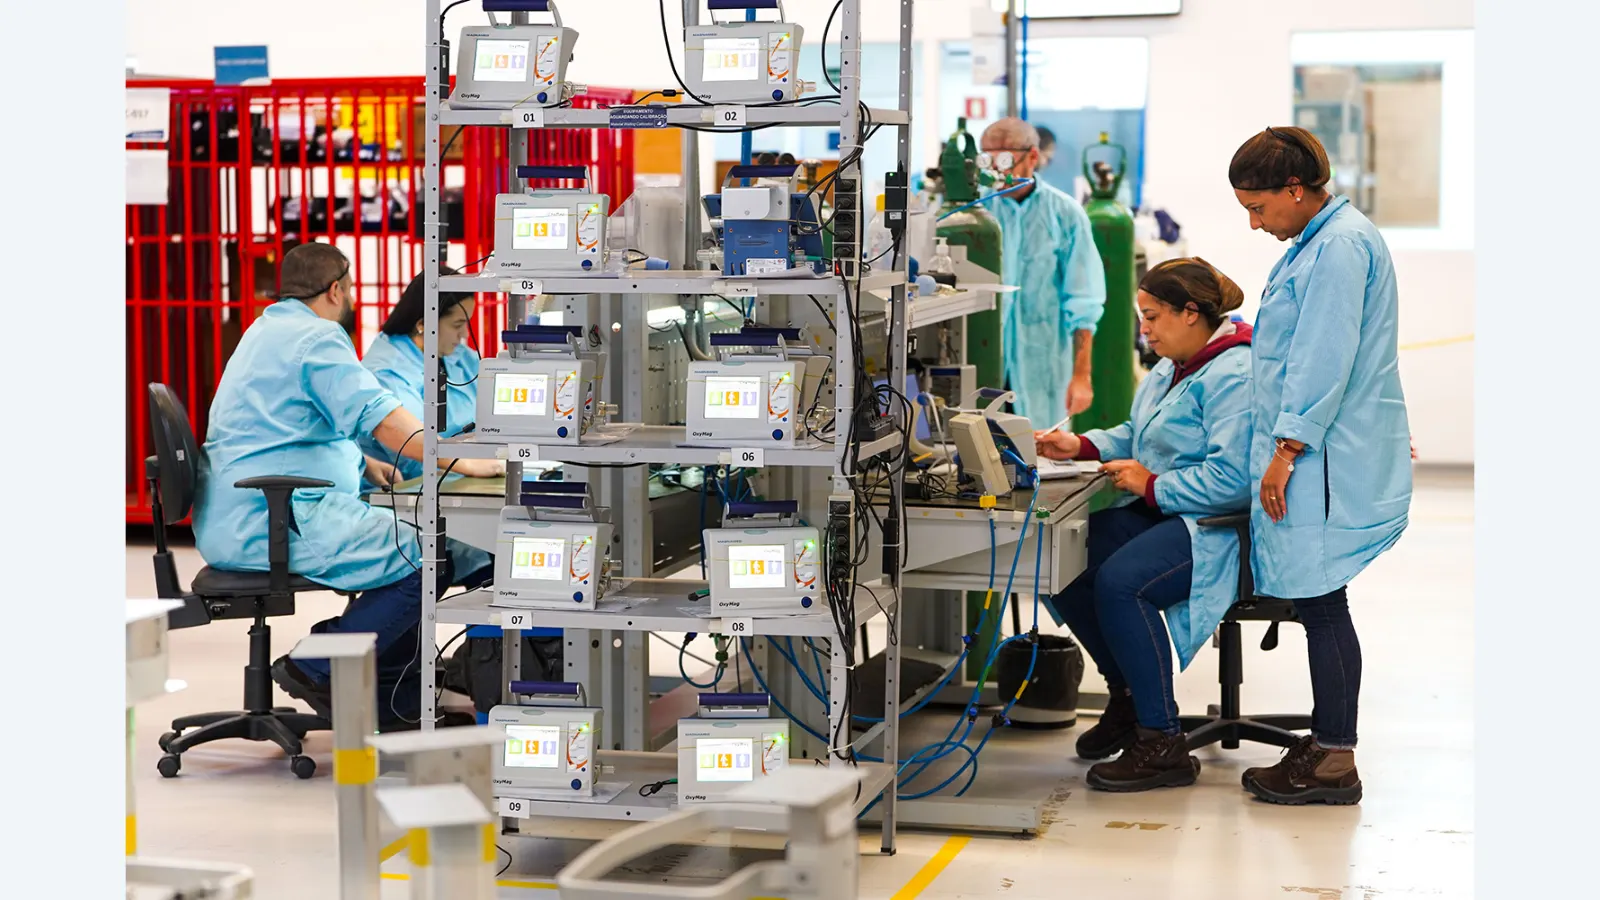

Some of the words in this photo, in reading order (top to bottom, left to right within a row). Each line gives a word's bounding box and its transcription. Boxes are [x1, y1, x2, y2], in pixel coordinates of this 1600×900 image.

[523, 113, 535, 122] 01
[724, 111, 737, 121] 02
[521, 280, 534, 290] 03
[518, 448, 531, 458] 05
[742, 452, 755, 461] 06
[511, 616, 523, 625] 07
[732, 622, 745, 632] 08
[509, 802, 521, 811] 09
